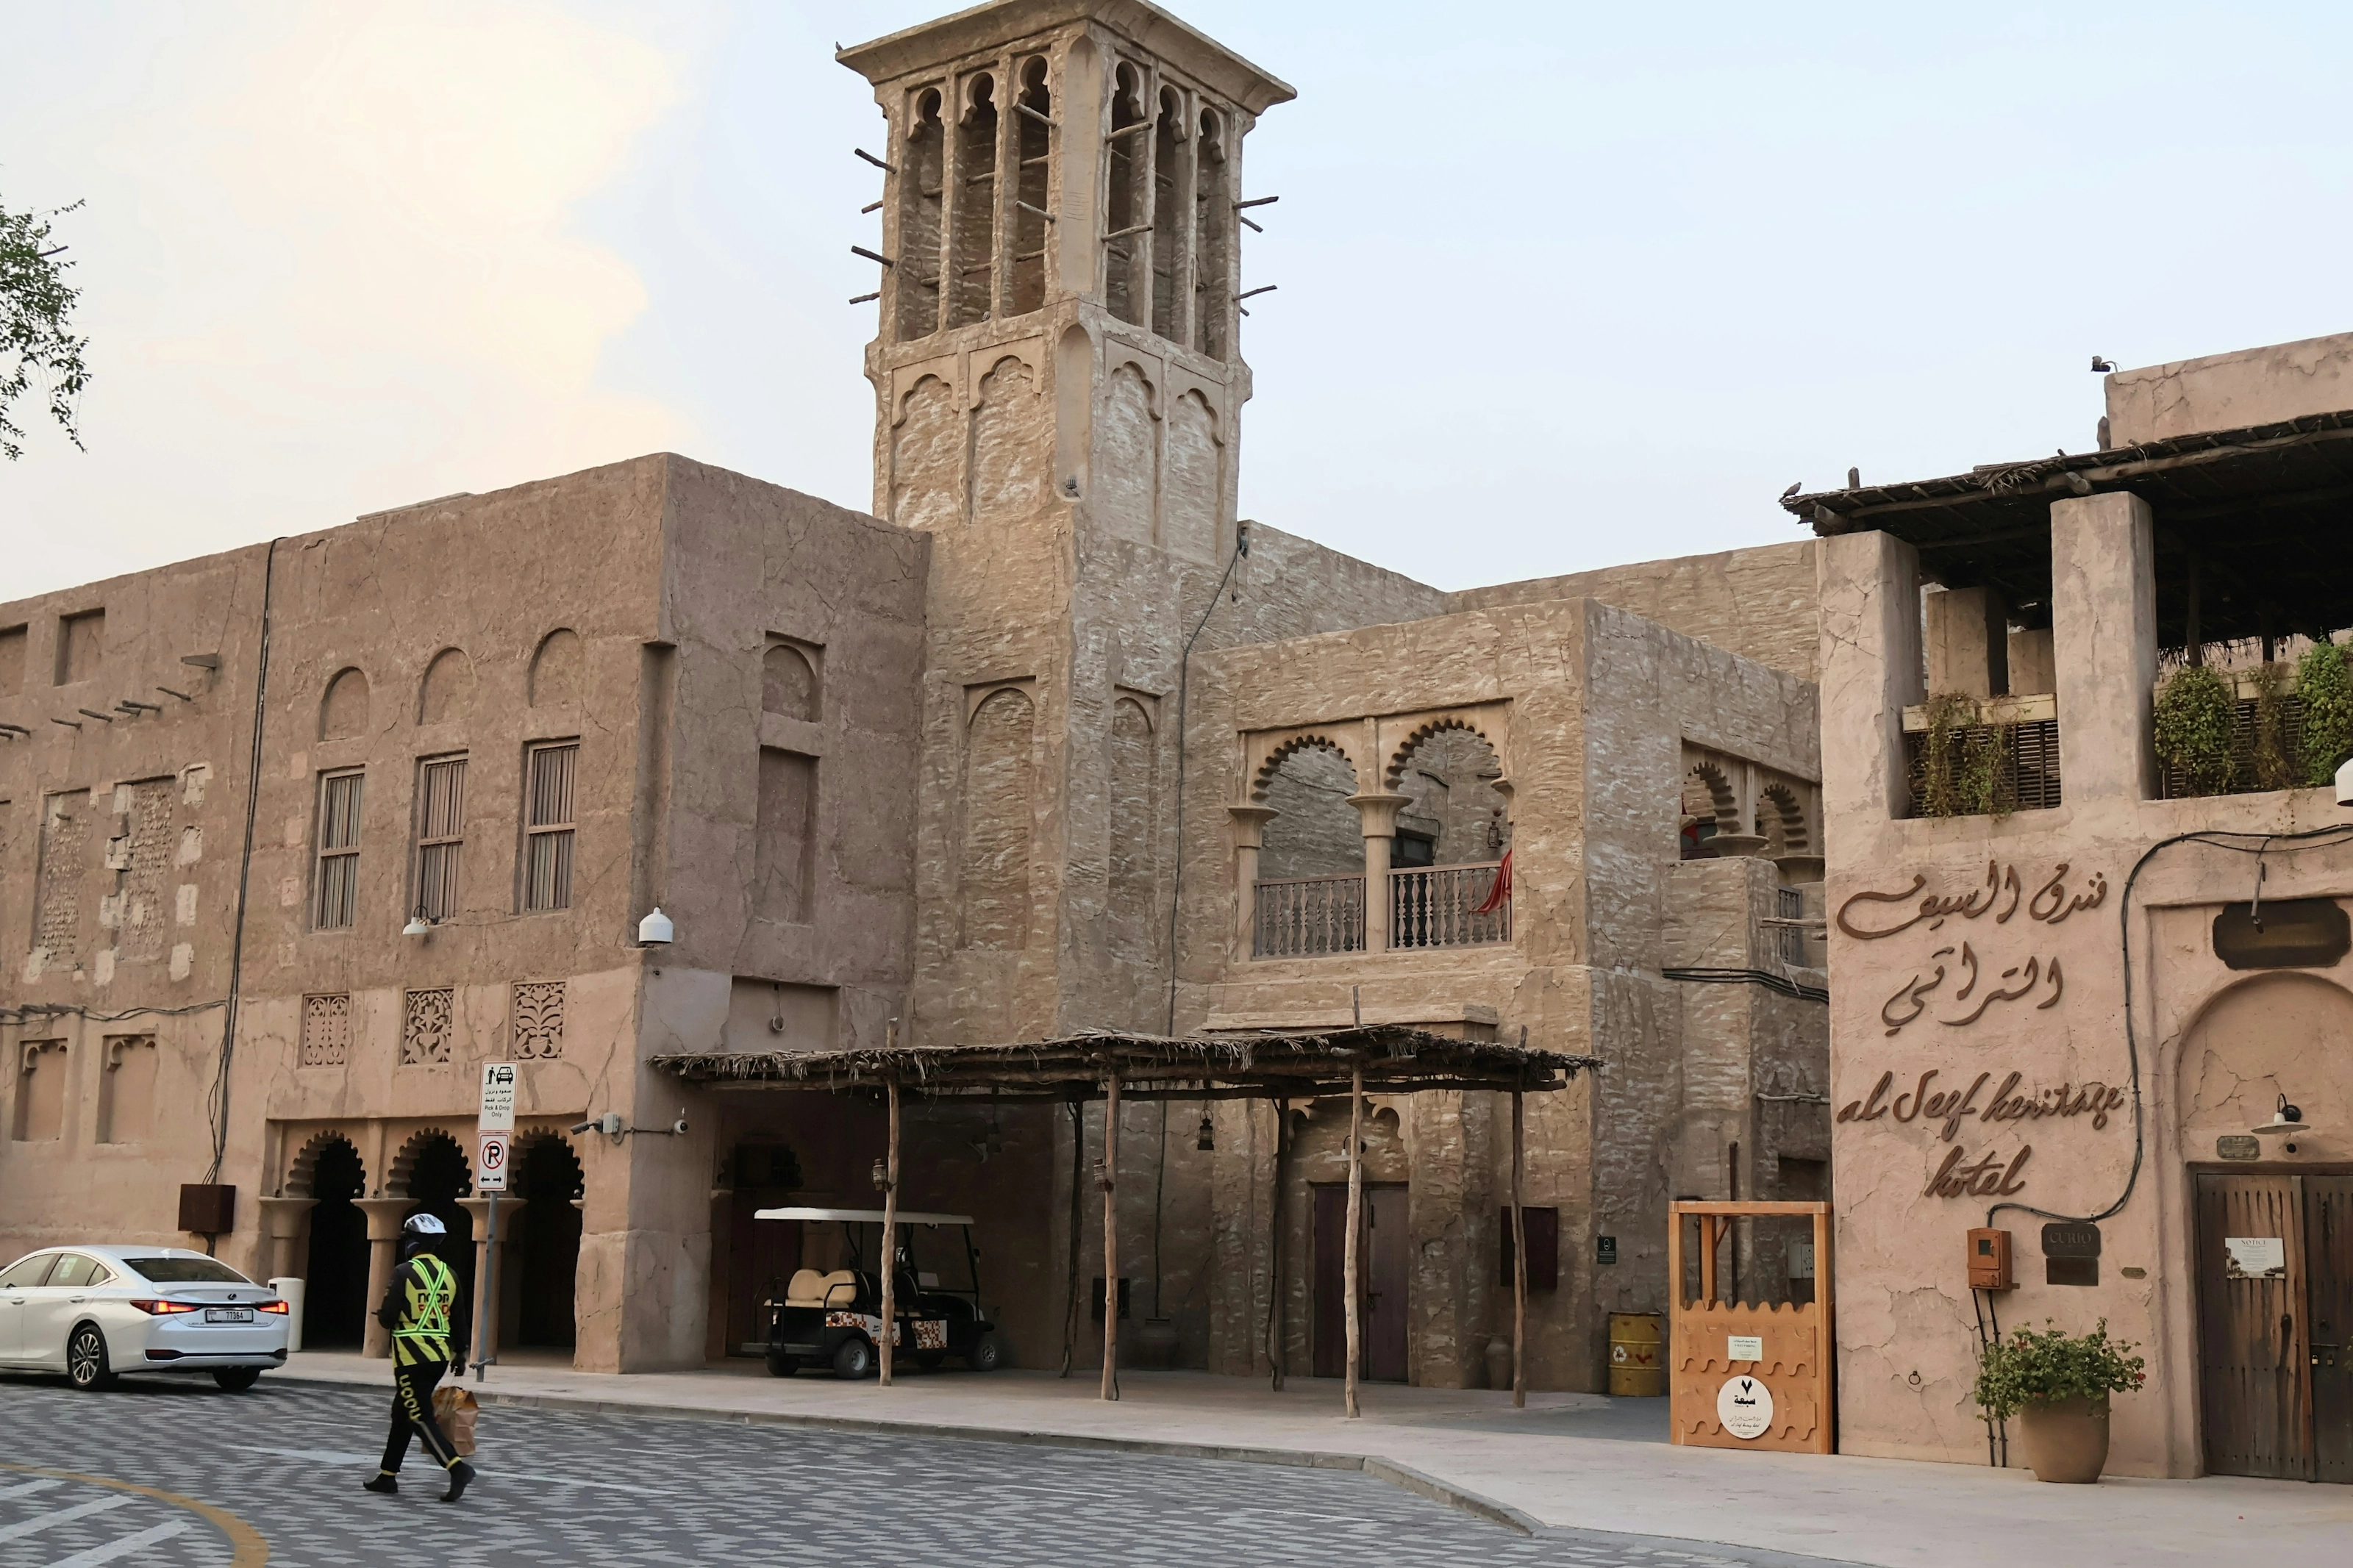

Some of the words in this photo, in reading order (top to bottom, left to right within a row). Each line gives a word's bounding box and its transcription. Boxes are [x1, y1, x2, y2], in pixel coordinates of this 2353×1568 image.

[1836, 859, 2021, 939] السيف
[2029, 862, 2107, 924] فندق
[1881, 940, 2064, 1037] التراثي
[1836, 1070, 1893, 1123] al
[1893, 1069, 1990, 1142] Seef
[1980, 1071, 2124, 1130] heritage
[488, 1145, 500, 1164] P
[1924, 1144, 2031, 1198] hotel
[2049, 1232, 2092, 1245] CURIO
[226, 1311, 243, 1320] 77364
[418, 1304, 450, 1314] FD
[399, 1373, 421, 1420] noon
[1734, 1395, 1756, 1408] سبعة
